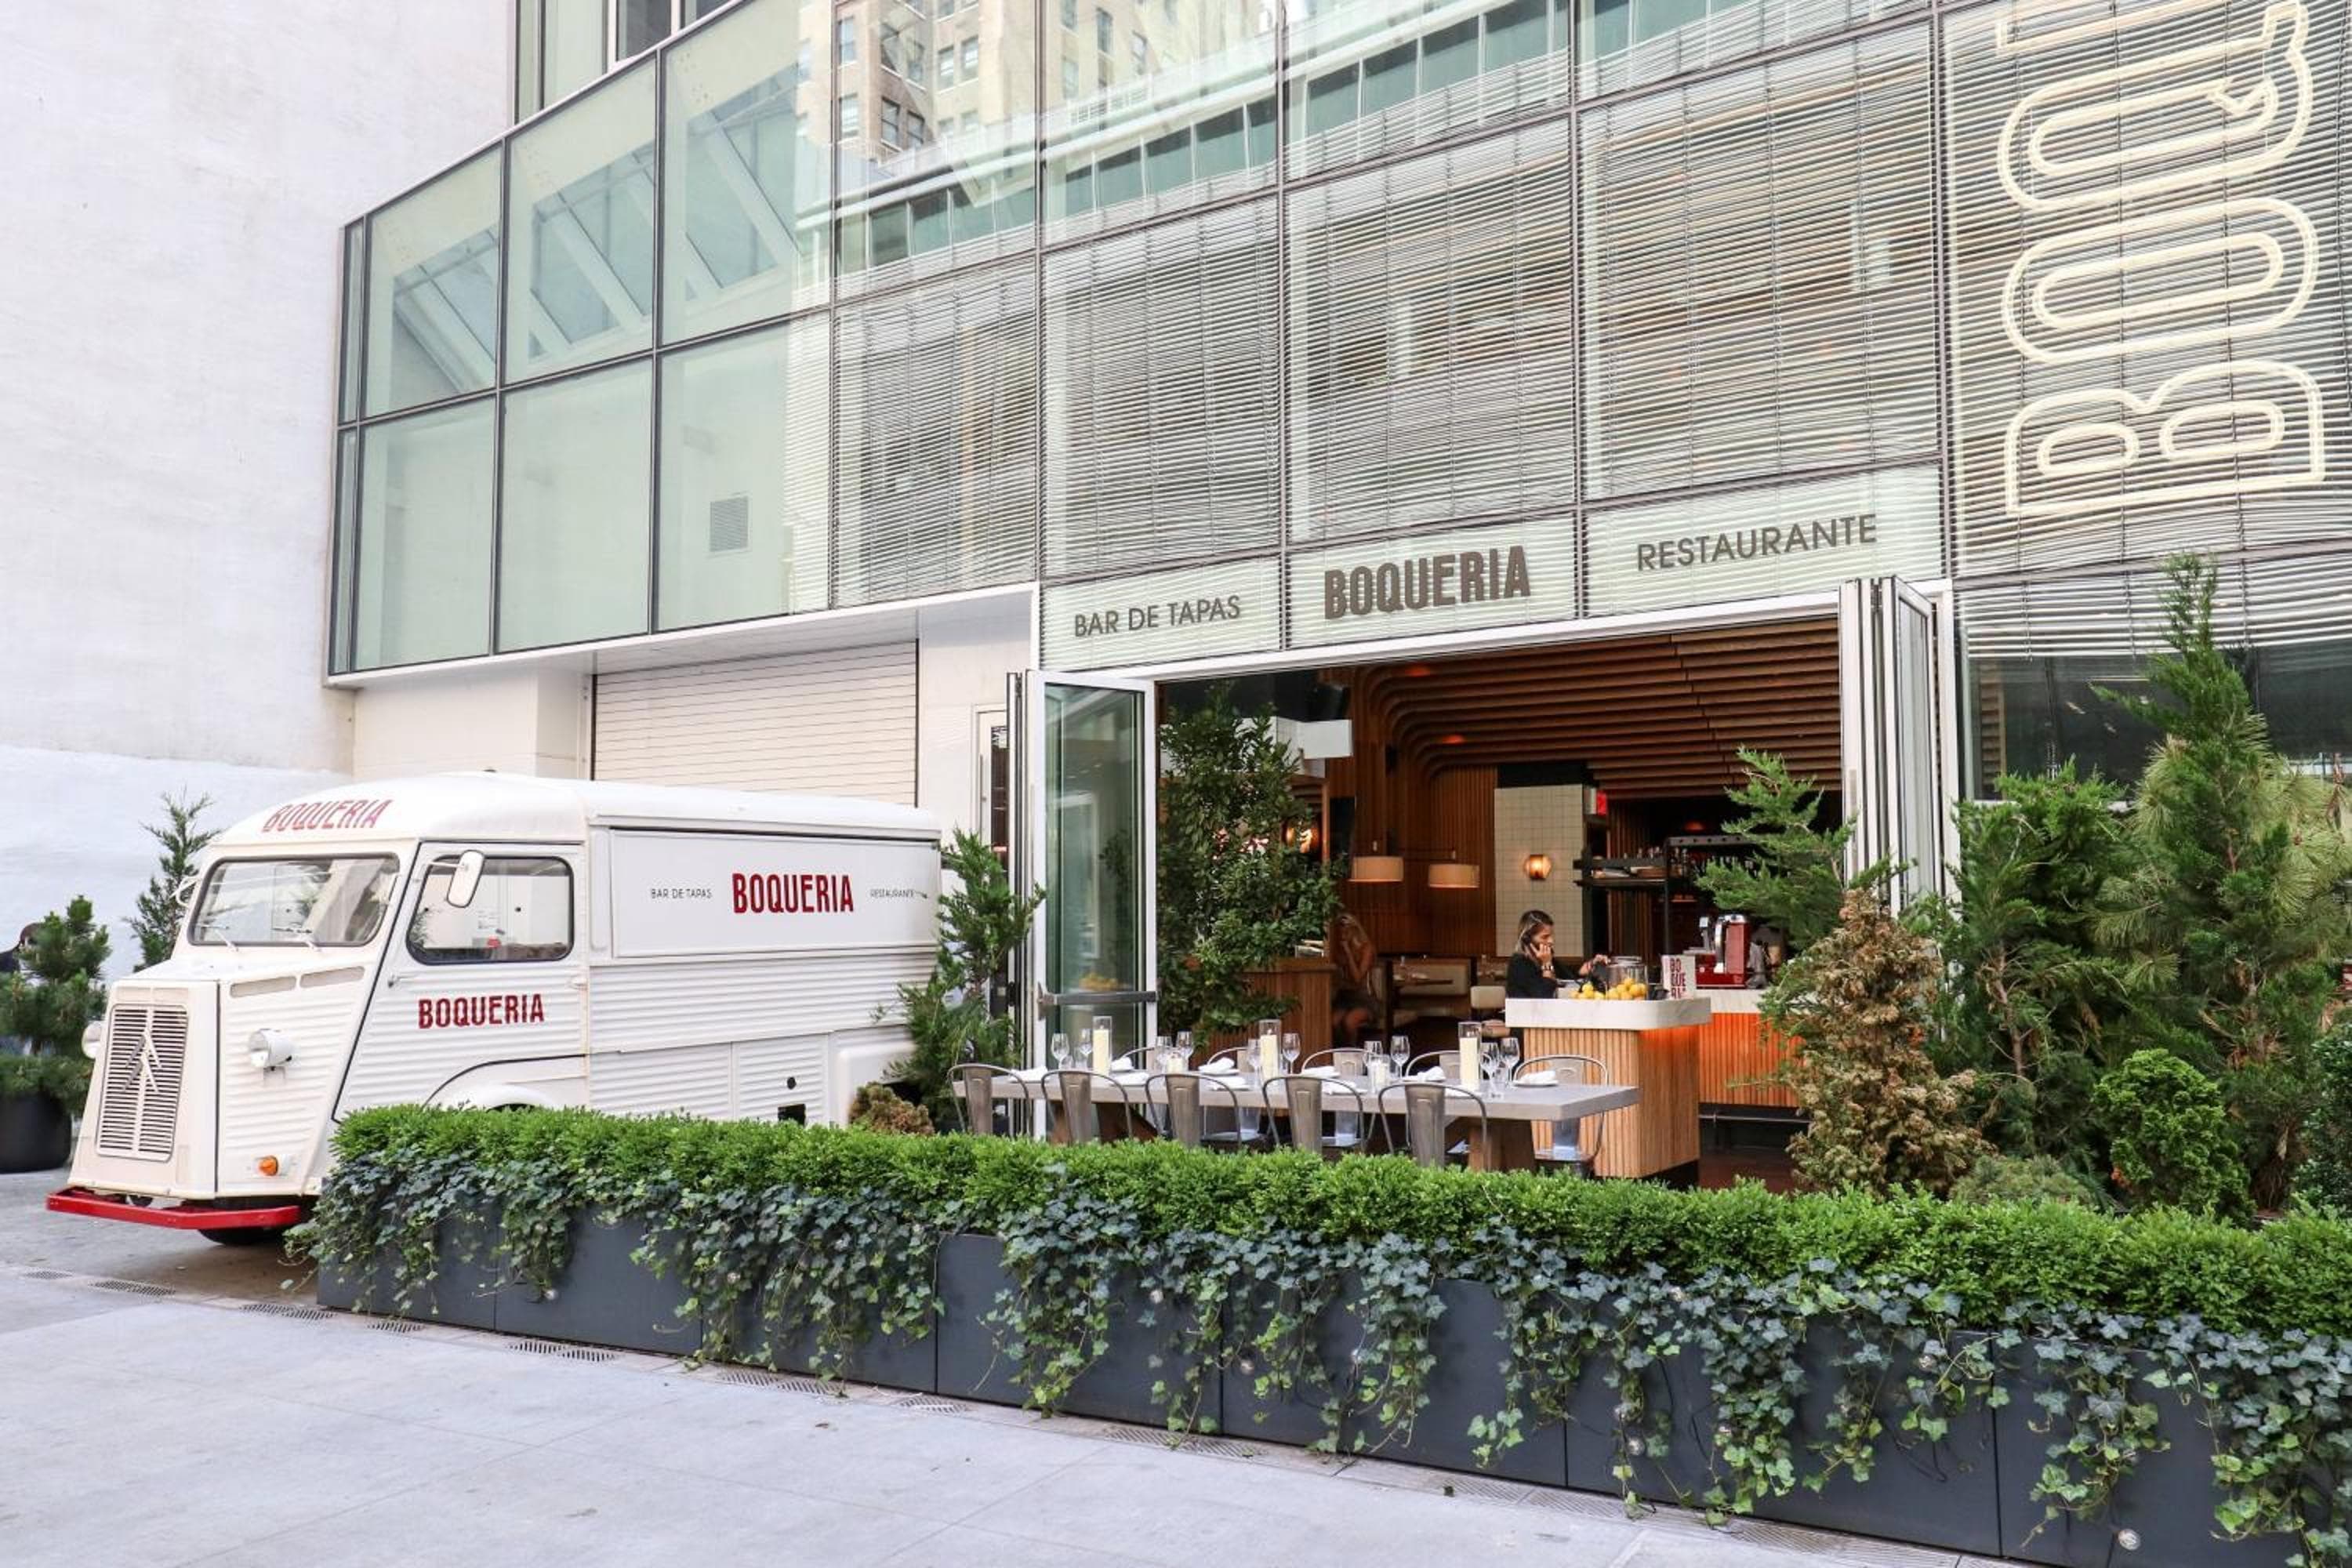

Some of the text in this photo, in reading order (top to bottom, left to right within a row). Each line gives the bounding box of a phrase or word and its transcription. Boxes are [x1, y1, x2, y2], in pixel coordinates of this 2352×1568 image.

[1638, 514, 1877, 572] RESTAURANTE
[1325, 545, 1531, 620] BOQUERIA
[1074, 594, 1241, 637] BAR DE TAPAS
[261, 800, 391, 833] BOQUERIA
[652, 888, 713, 899] BAR DE TAPAS
[732, 873, 855, 914] BOQUERIA
[418, 994, 545, 1029] BOQUERIA
